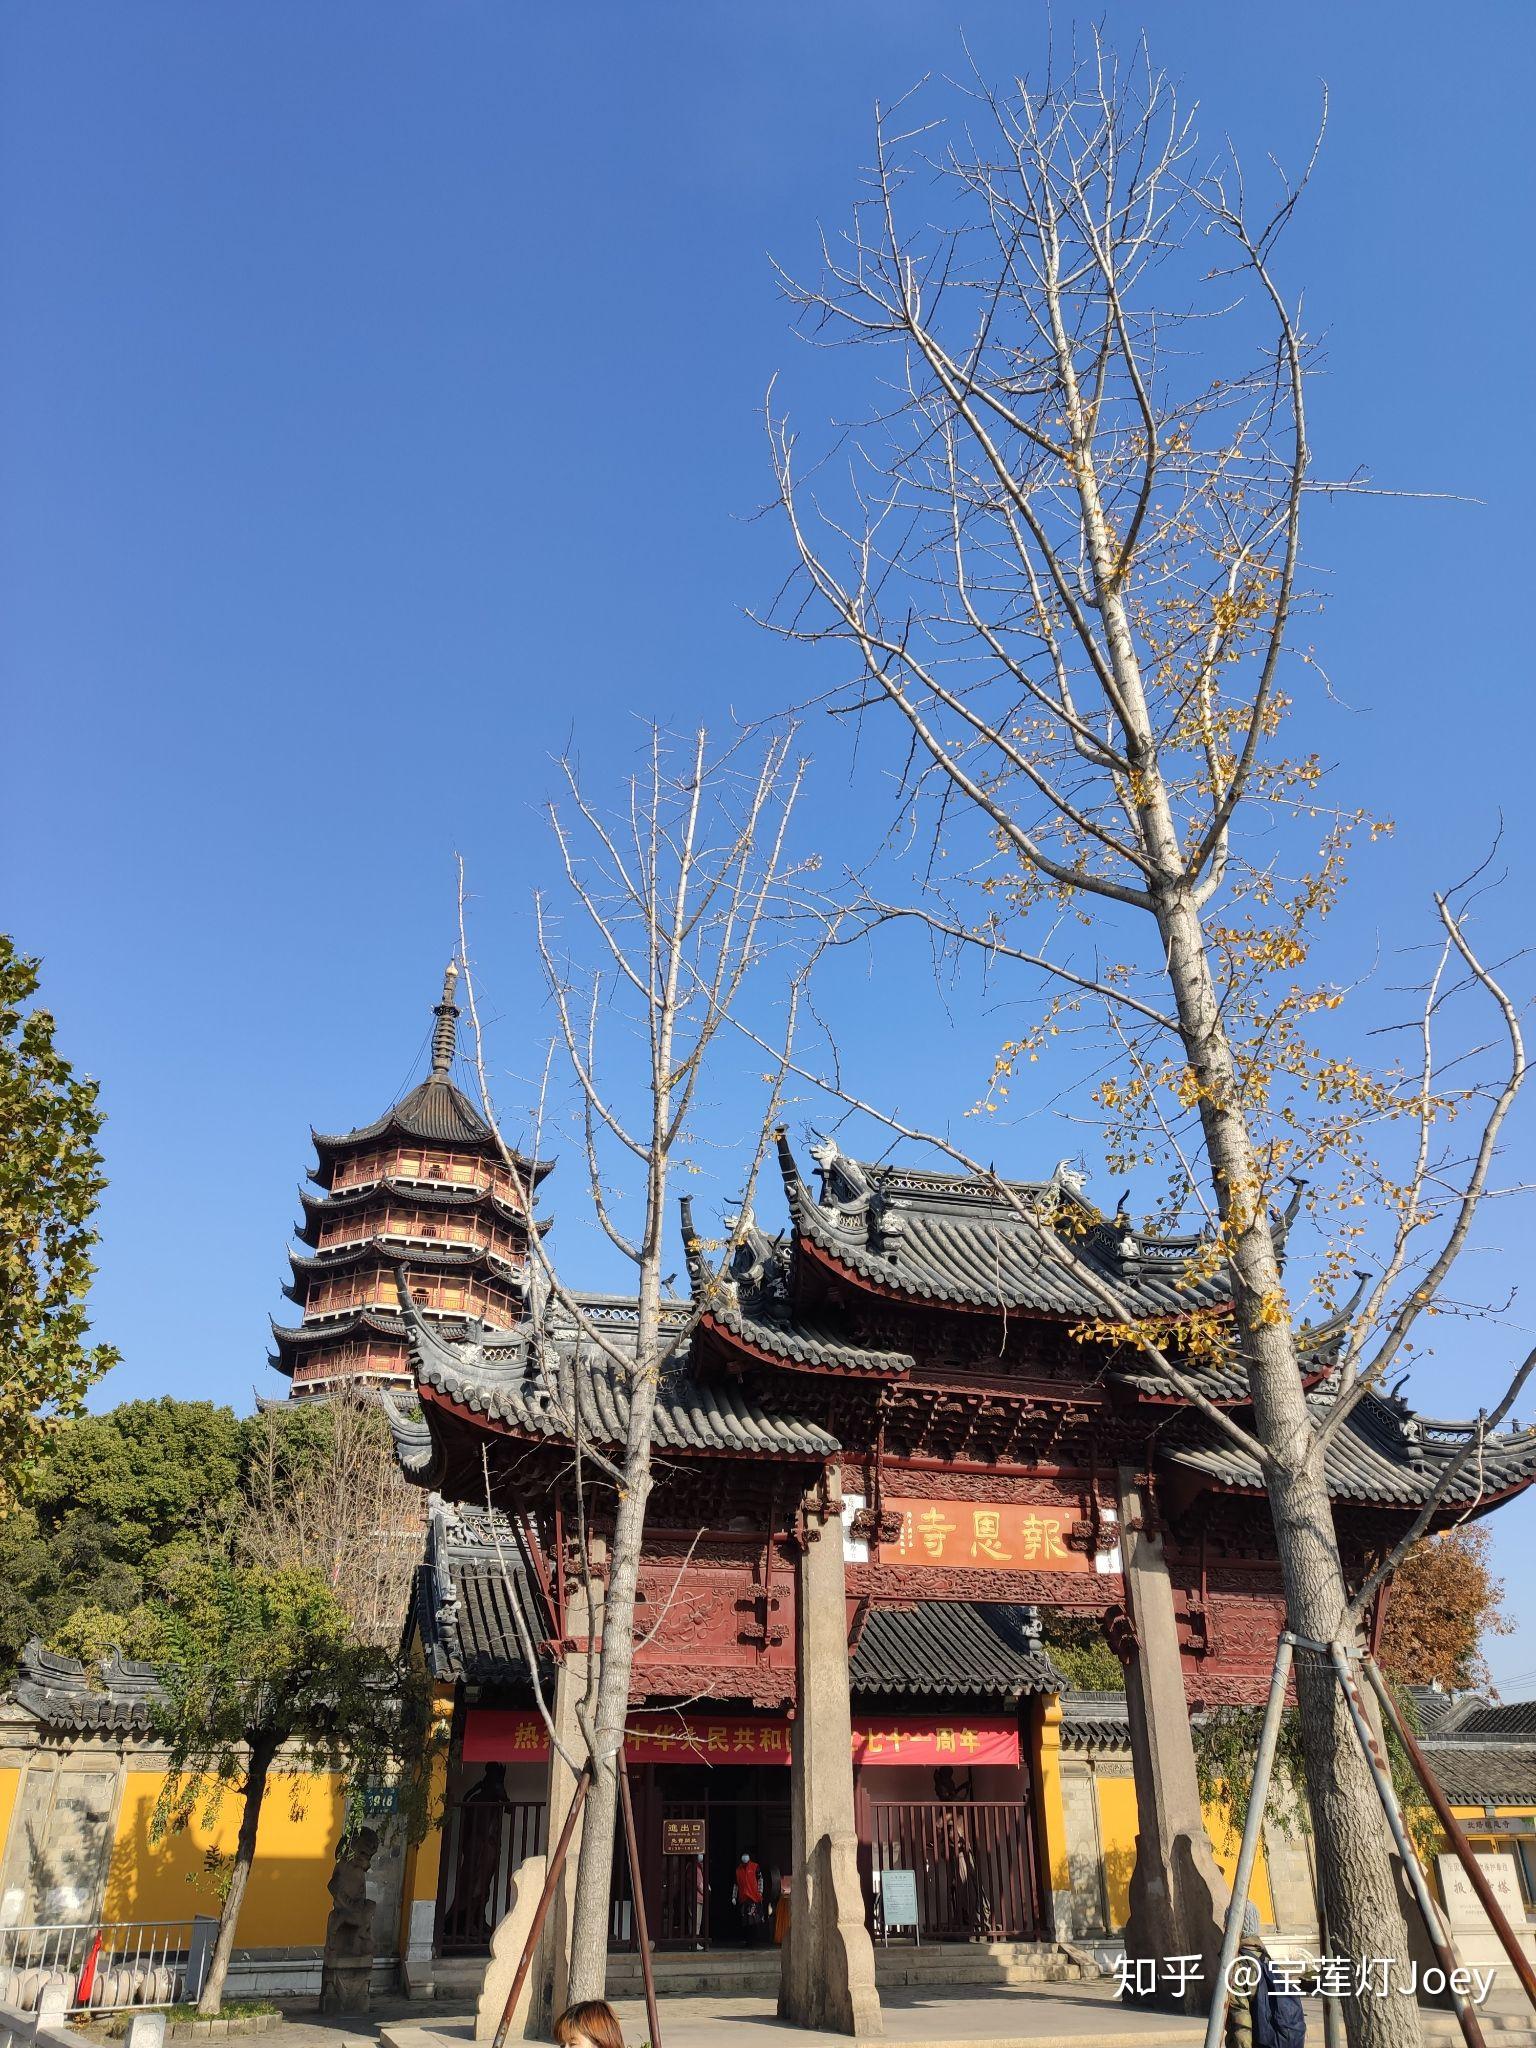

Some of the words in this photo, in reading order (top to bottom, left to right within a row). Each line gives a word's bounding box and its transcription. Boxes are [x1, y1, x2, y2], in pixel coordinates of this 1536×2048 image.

[626, 1724, 792, 1753] 中华人民共和
